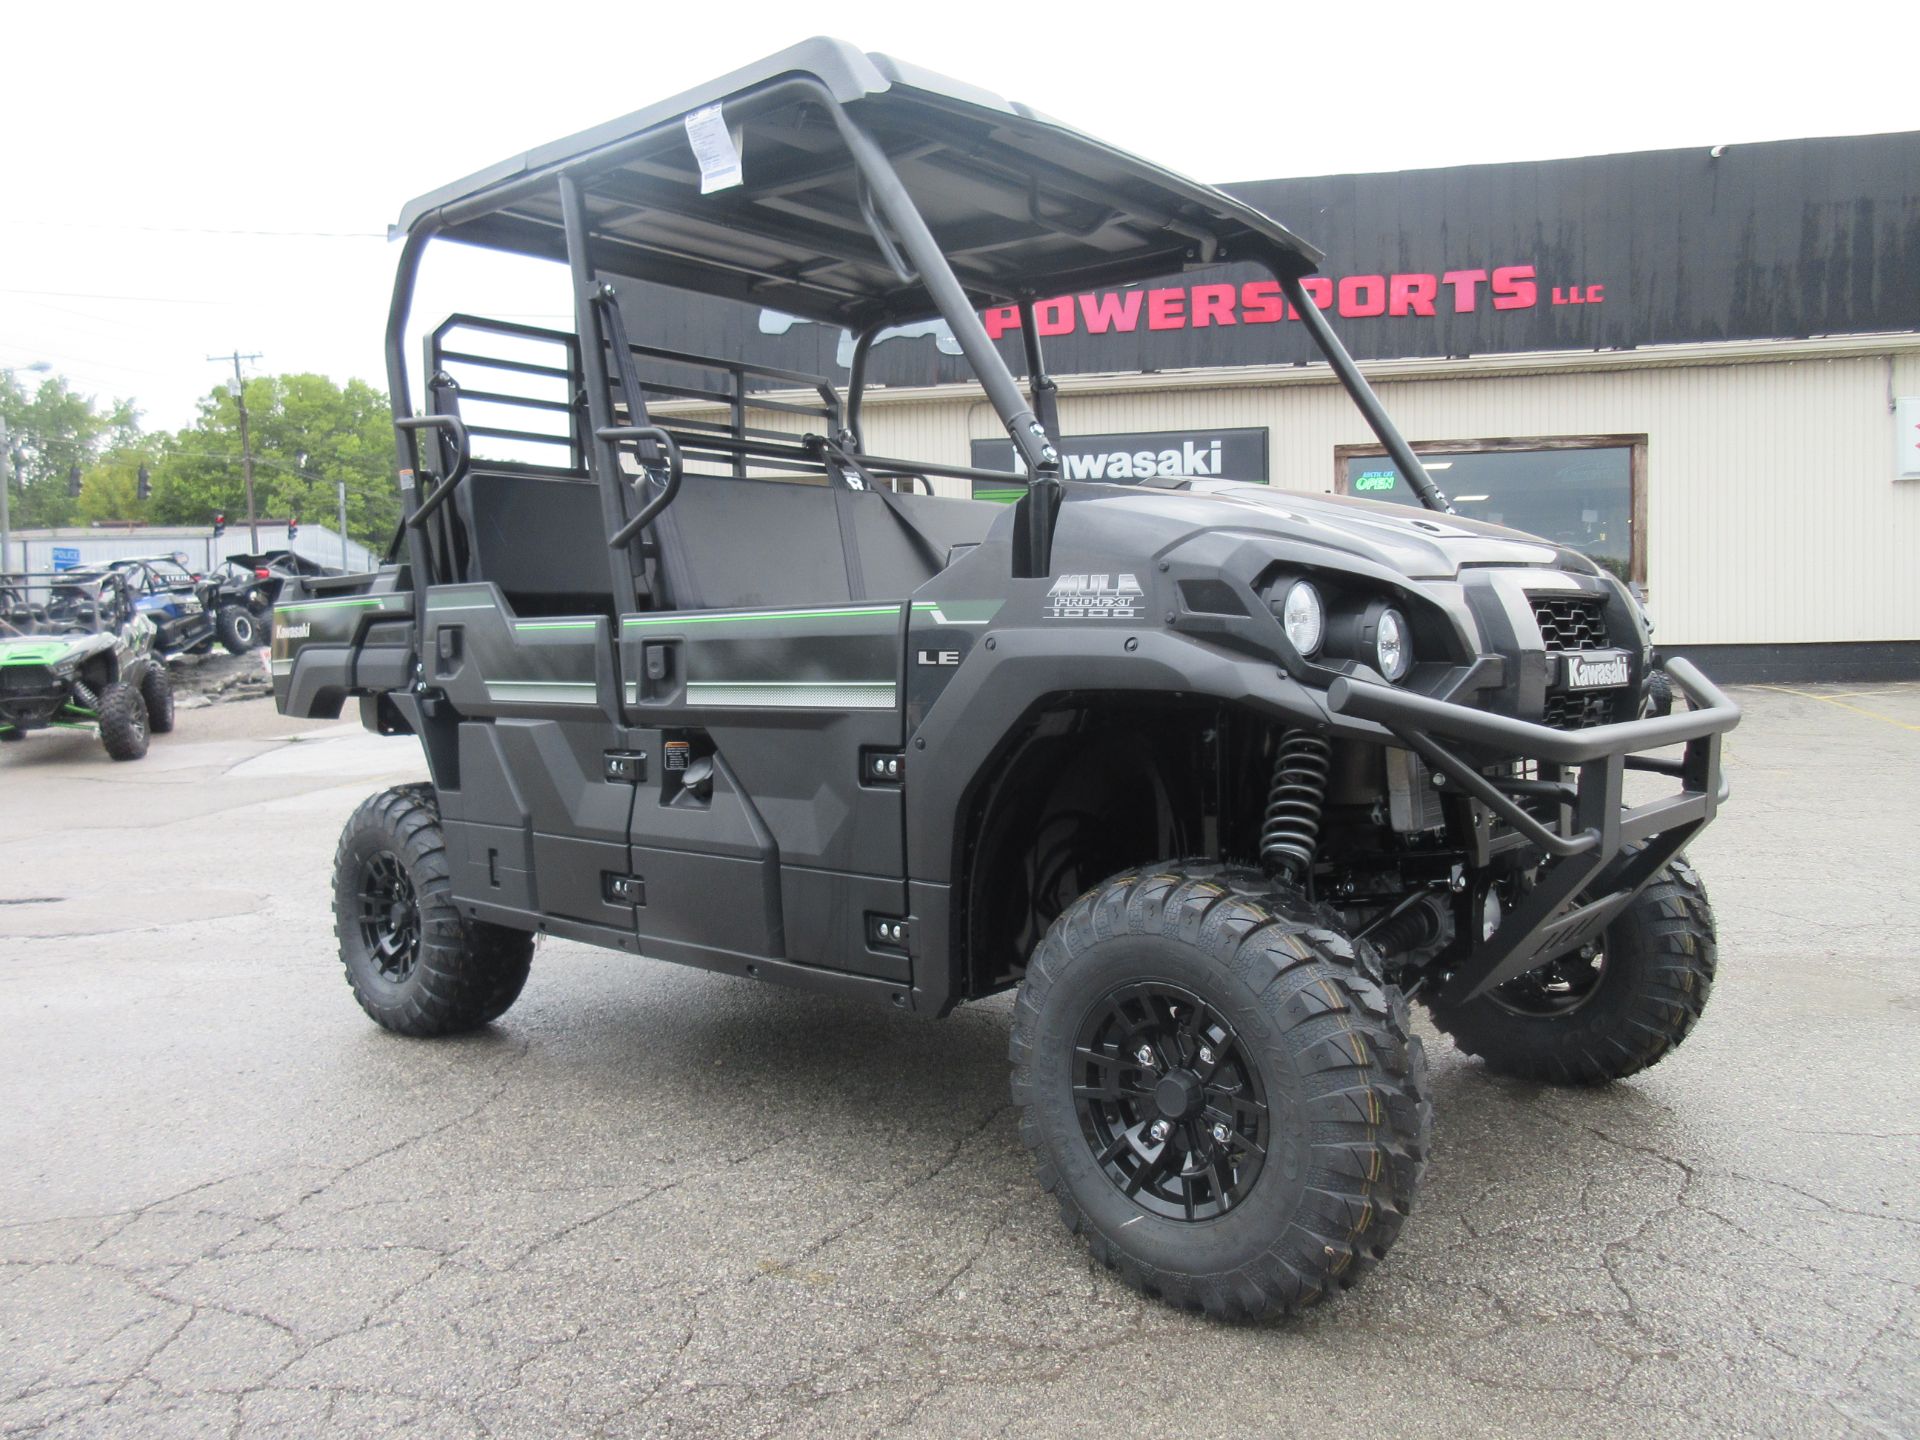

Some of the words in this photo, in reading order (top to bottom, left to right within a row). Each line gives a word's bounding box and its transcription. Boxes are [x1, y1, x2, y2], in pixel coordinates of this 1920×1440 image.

[985, 265, 1538, 339] POWERSPORTS
[1552, 284, 1605, 305] LLC
[1355, 477, 1395, 491] OPEN
[53, 550, 79, 560] POLICE
[1046, 573, 1145, 597] MULE
[1054, 596, 1135, 607] PRO-FXT
[1053, 608, 1135, 617] 1000
[275, 622, 311, 639] Kawasaki
[918, 651, 959, 665] LE
[1568, 656, 1628, 687] Kawasaki
